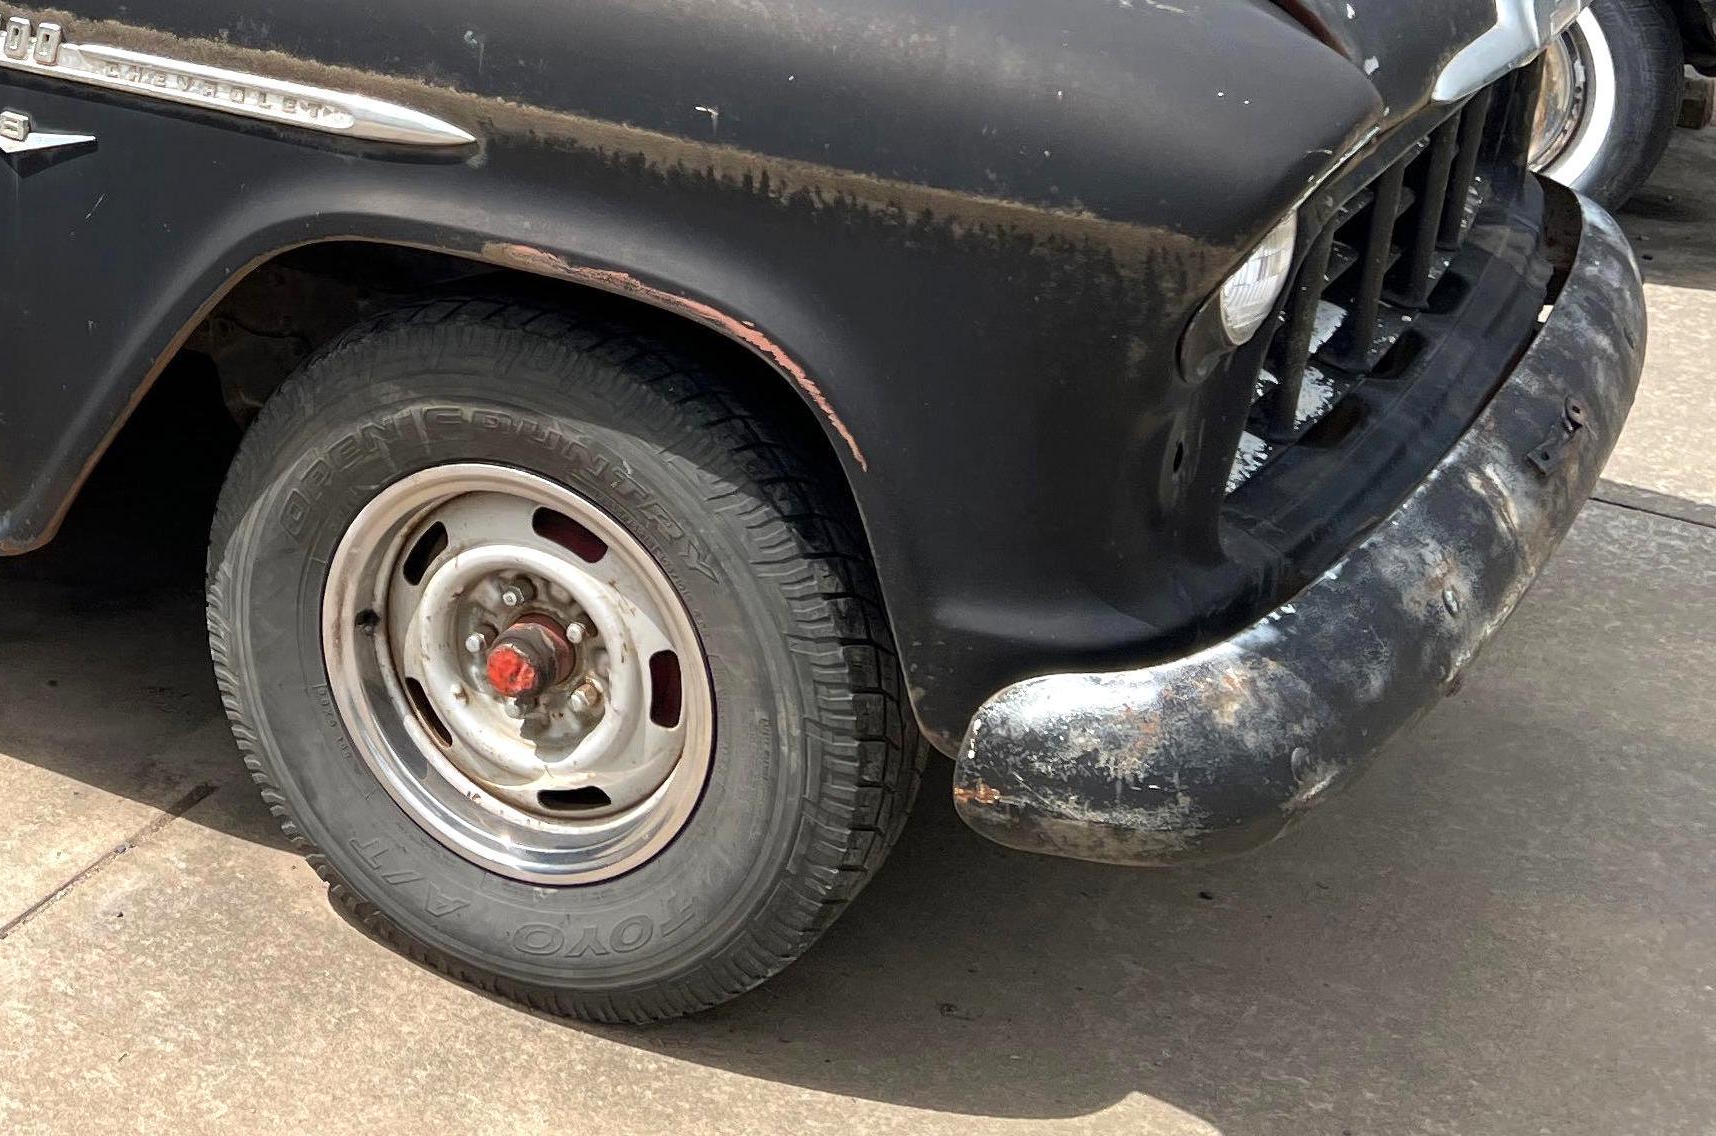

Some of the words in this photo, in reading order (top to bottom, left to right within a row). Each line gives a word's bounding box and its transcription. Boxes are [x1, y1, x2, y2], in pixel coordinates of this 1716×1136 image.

[104, 60, 323, 123] CHEVROLET
[281, 407, 409, 536] OPEN
[423, 405, 720, 584] COUNTRY
[349, 836, 471, 918] A/T
[512, 890, 696, 958] TOYO
